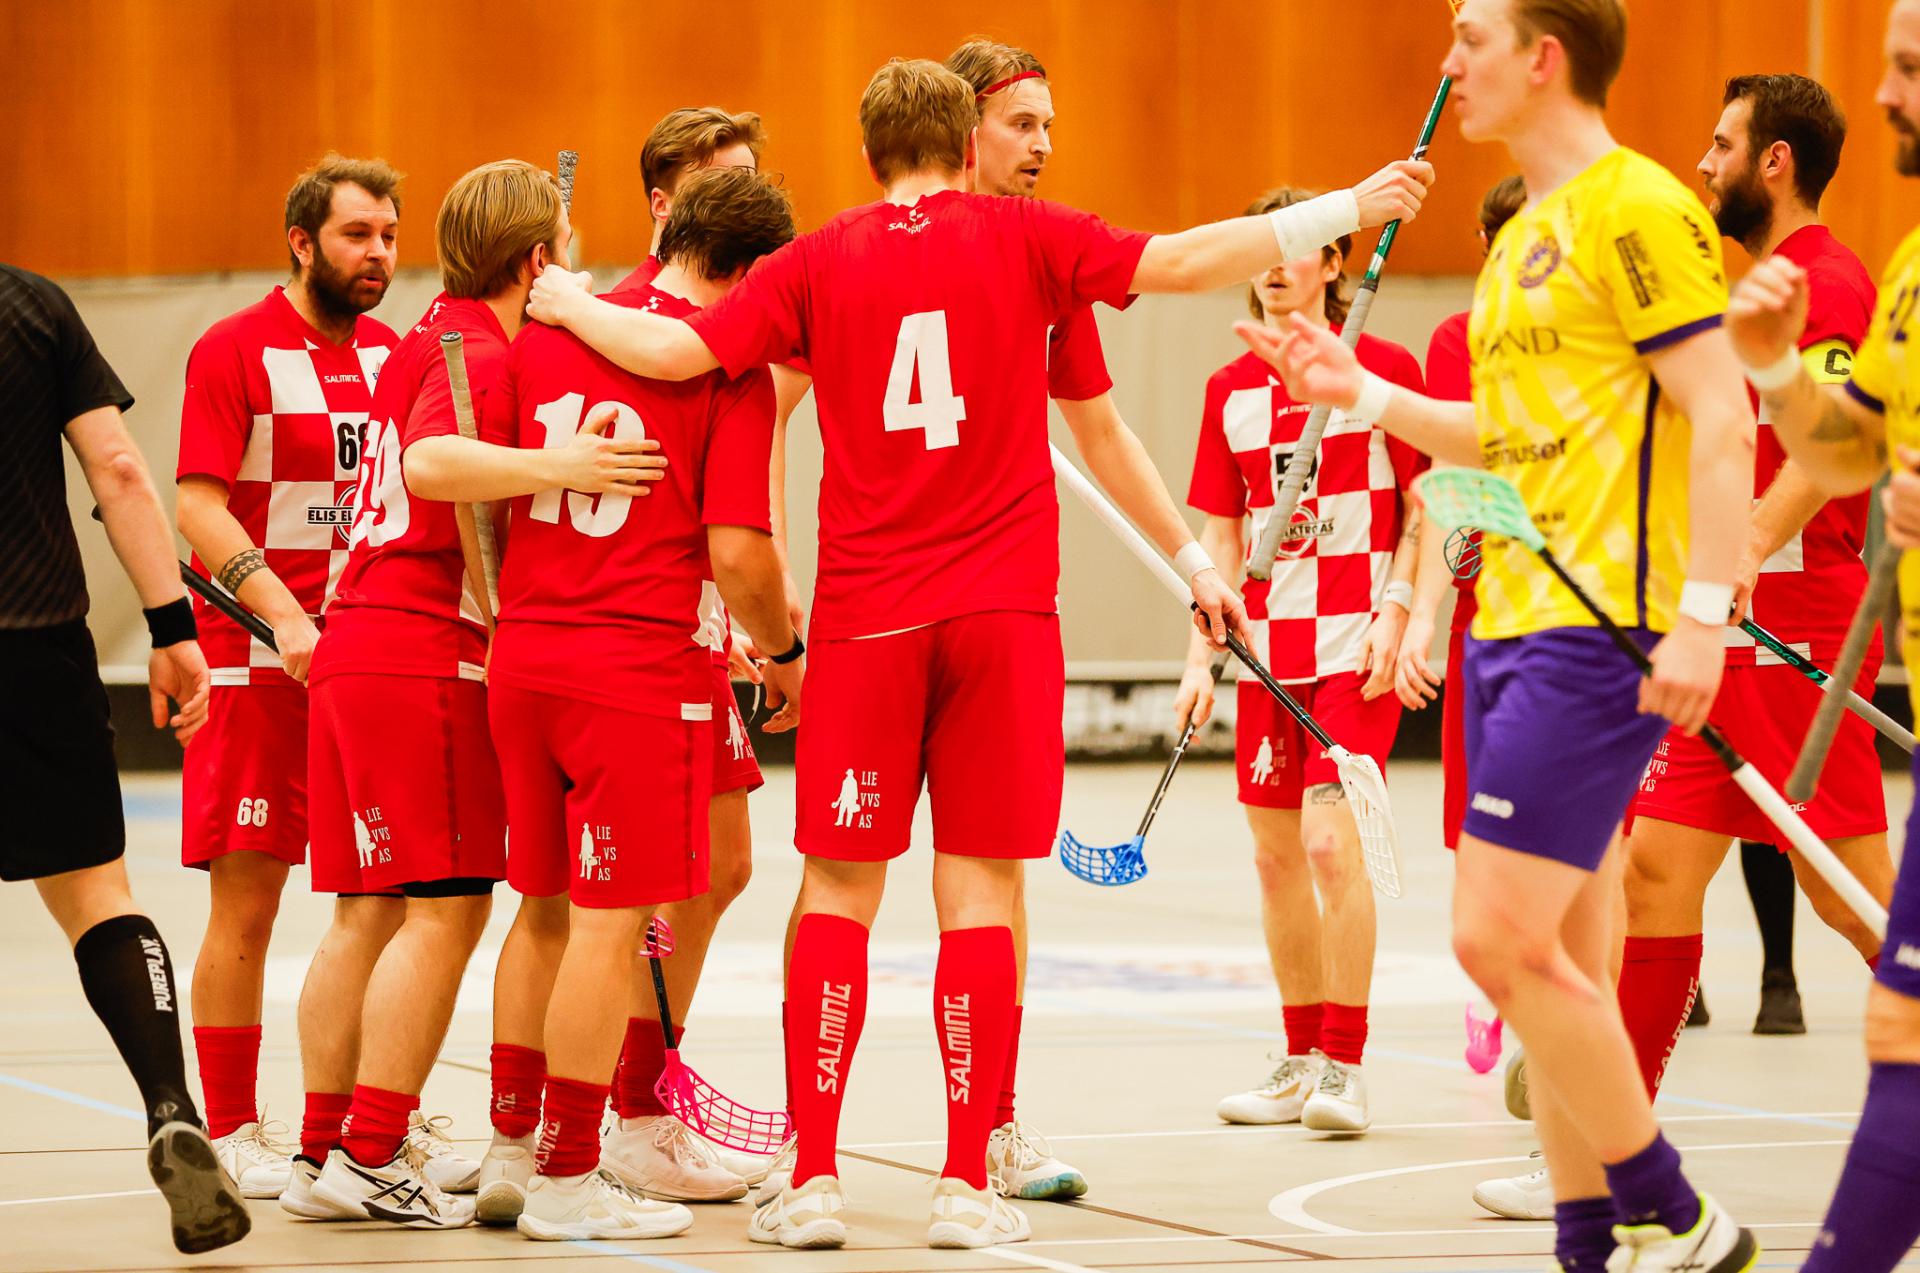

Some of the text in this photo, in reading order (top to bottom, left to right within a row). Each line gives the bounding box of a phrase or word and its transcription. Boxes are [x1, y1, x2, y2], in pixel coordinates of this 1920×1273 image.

[1824, 348, 1852, 376] C
[324, 374, 362, 384] SALMING
[883, 310, 967, 450] 4
[529, 391, 646, 538] 19
[307, 510, 337, 522] ELIS
[861, 770, 878, 786] LIE
[860, 792, 881, 808] VVS
[236, 797, 269, 828] 68
[365, 806, 383, 823] LIE
[858, 814, 873, 829] AS
[371, 826, 391, 843] VVS
[596, 825, 612, 840] LIE
[378, 847, 392, 864] AS
[597, 867, 611, 881] AS
[142, 937, 173, 1012] PUREPLAY
[817, 980, 852, 1095] SALMING
[943, 992, 971, 1105] SALMING
